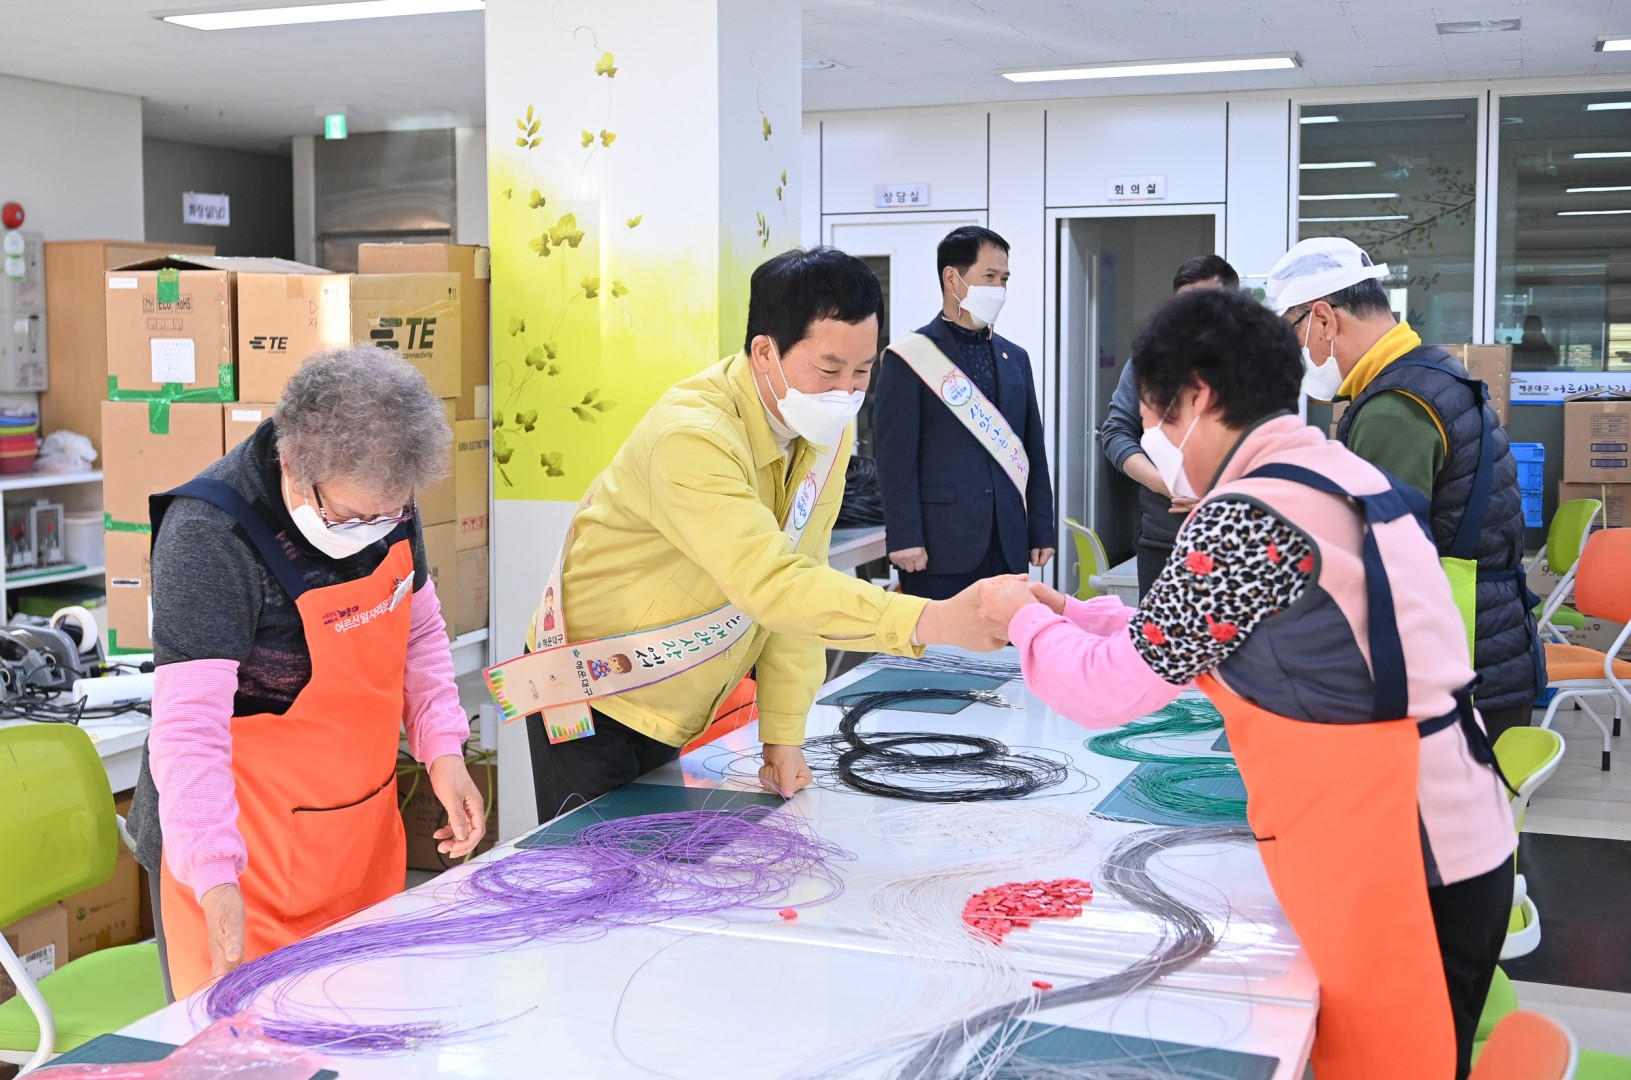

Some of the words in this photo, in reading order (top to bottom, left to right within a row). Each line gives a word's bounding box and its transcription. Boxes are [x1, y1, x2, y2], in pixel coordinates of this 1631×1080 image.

[269, 336, 289, 350] TE
[405, 317, 437, 350] TE
[402, 351, 433, 359] connectivity
[576, 660, 594, 696] 해운대구
